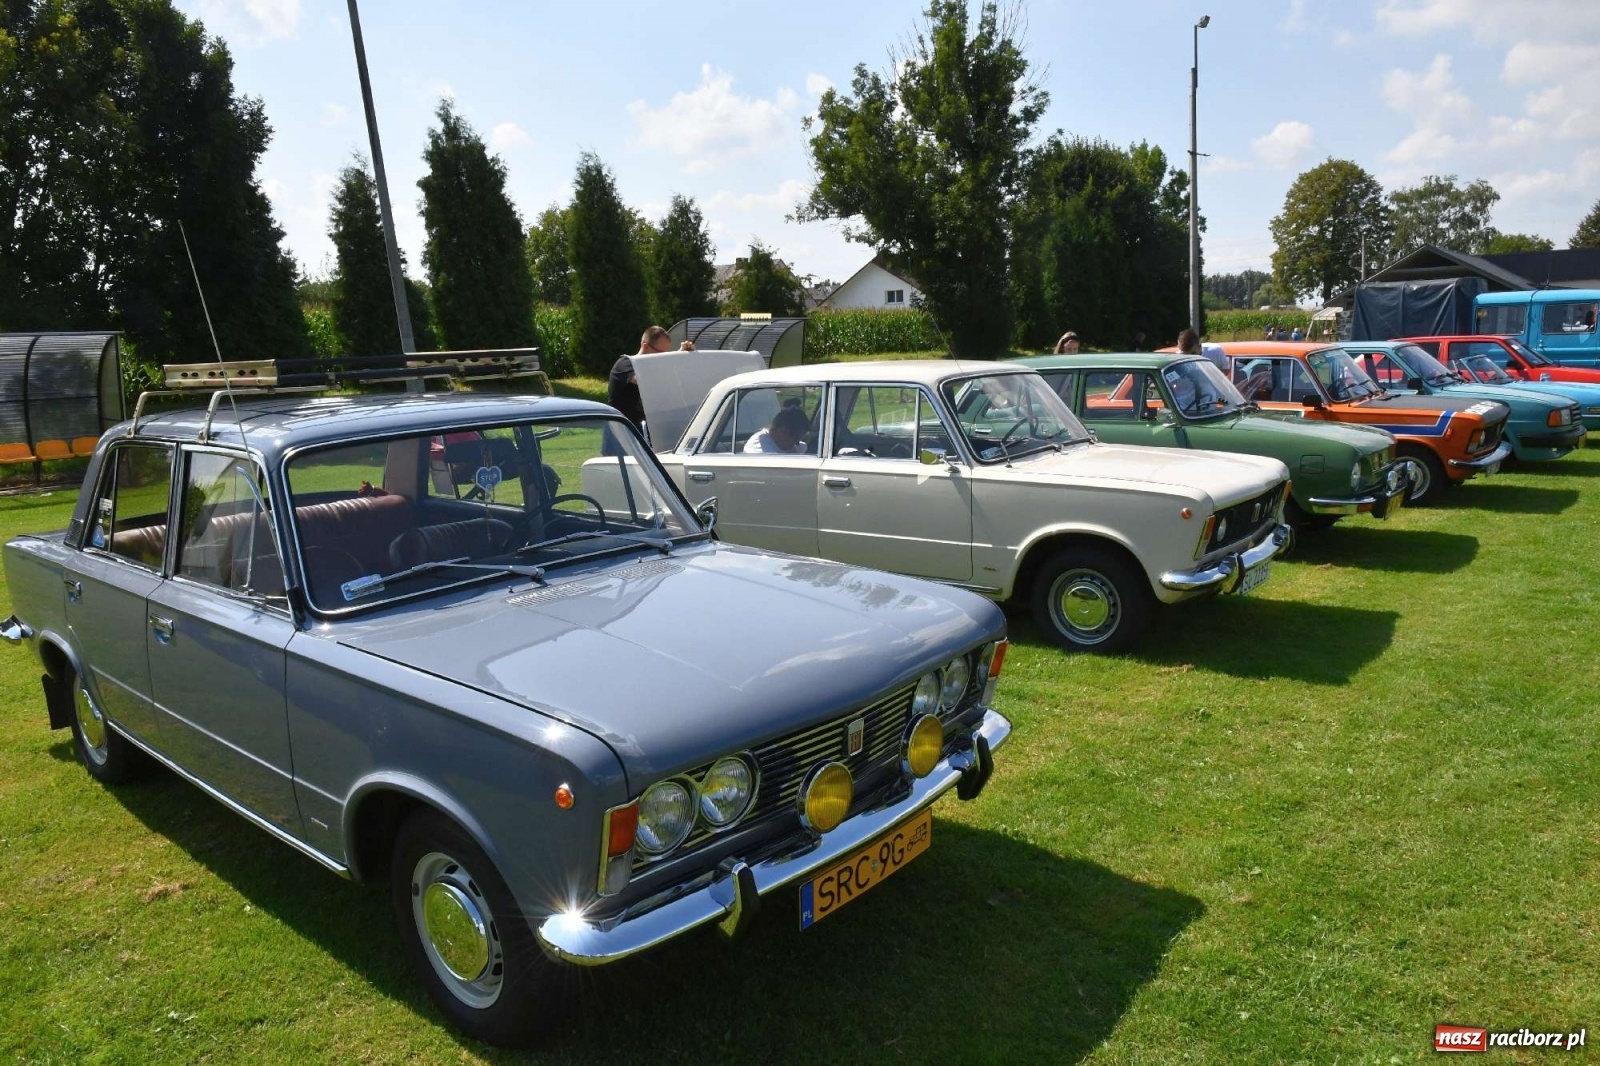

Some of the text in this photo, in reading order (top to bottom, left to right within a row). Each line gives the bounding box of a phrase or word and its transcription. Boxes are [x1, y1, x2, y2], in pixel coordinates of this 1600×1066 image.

[818, 833, 905, 913] SRC 9G
[802, 911, 813, 922] PL
